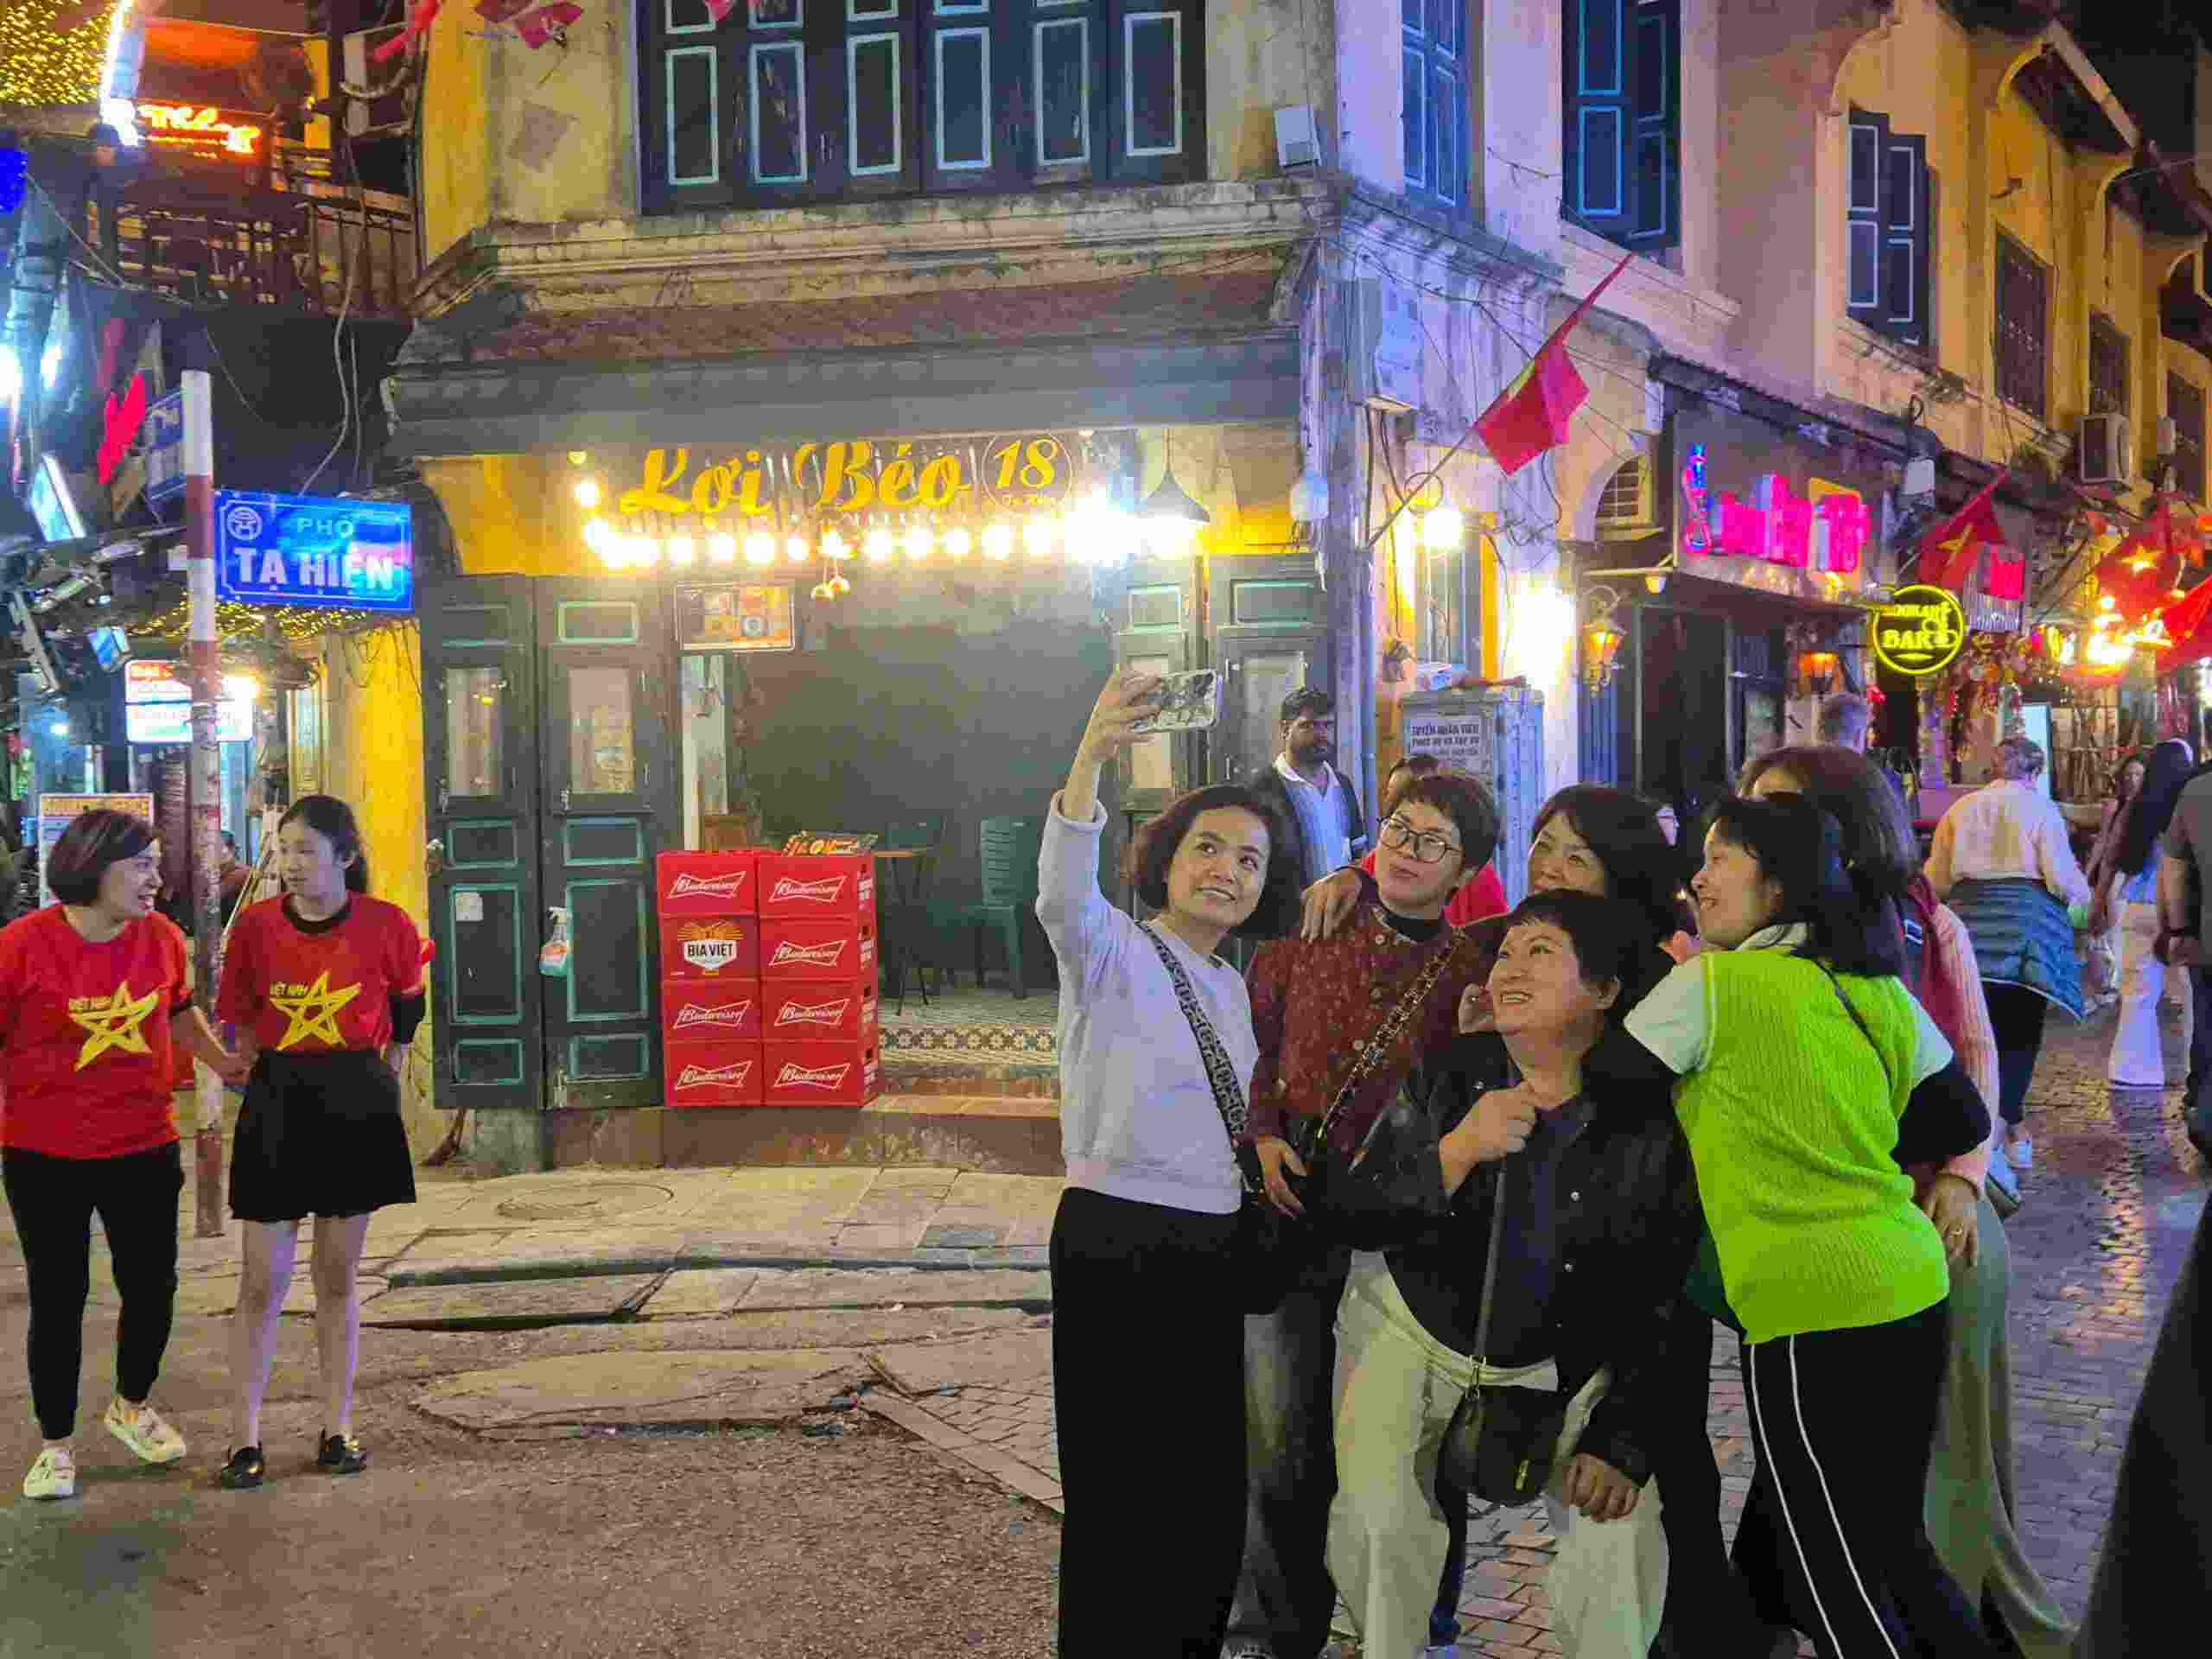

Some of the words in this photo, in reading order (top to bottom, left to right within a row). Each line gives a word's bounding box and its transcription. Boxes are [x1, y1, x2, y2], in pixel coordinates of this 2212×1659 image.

[994, 438, 1056, 489] 18
[234, 547, 289, 591] TẠ
[688, 944, 707, 957] BIA
